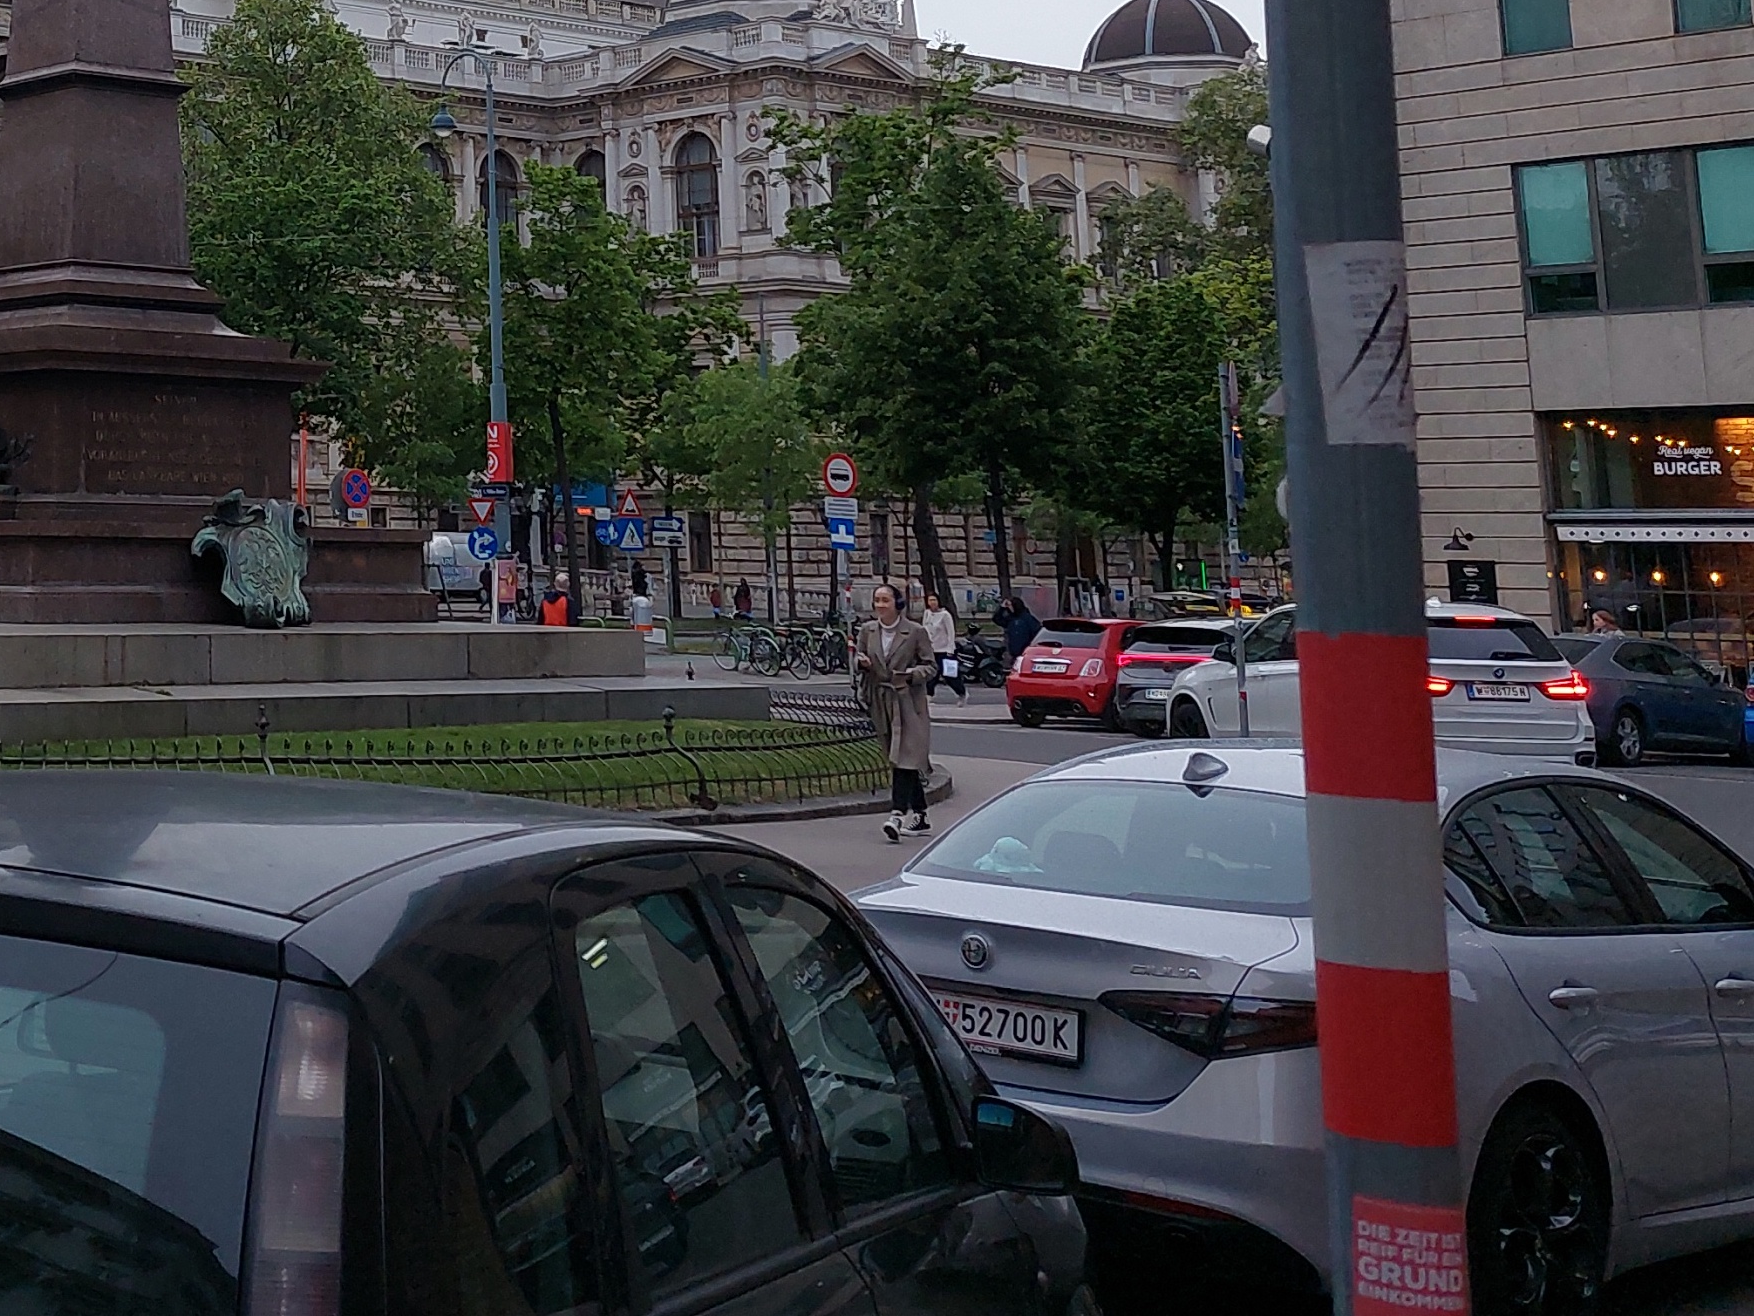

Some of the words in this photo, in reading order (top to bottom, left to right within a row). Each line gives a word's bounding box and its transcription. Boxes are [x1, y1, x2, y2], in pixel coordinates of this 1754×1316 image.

[1657, 445, 1683, 459] Real
[1684, 446, 1714, 459] vegan
[1653, 461, 1723, 476] BURGER
[1358, 1220, 1391, 1242] DIE
[1395, 1228, 1438, 1248] ZEIT
[1358, 1256, 1463, 1293] GRUND
